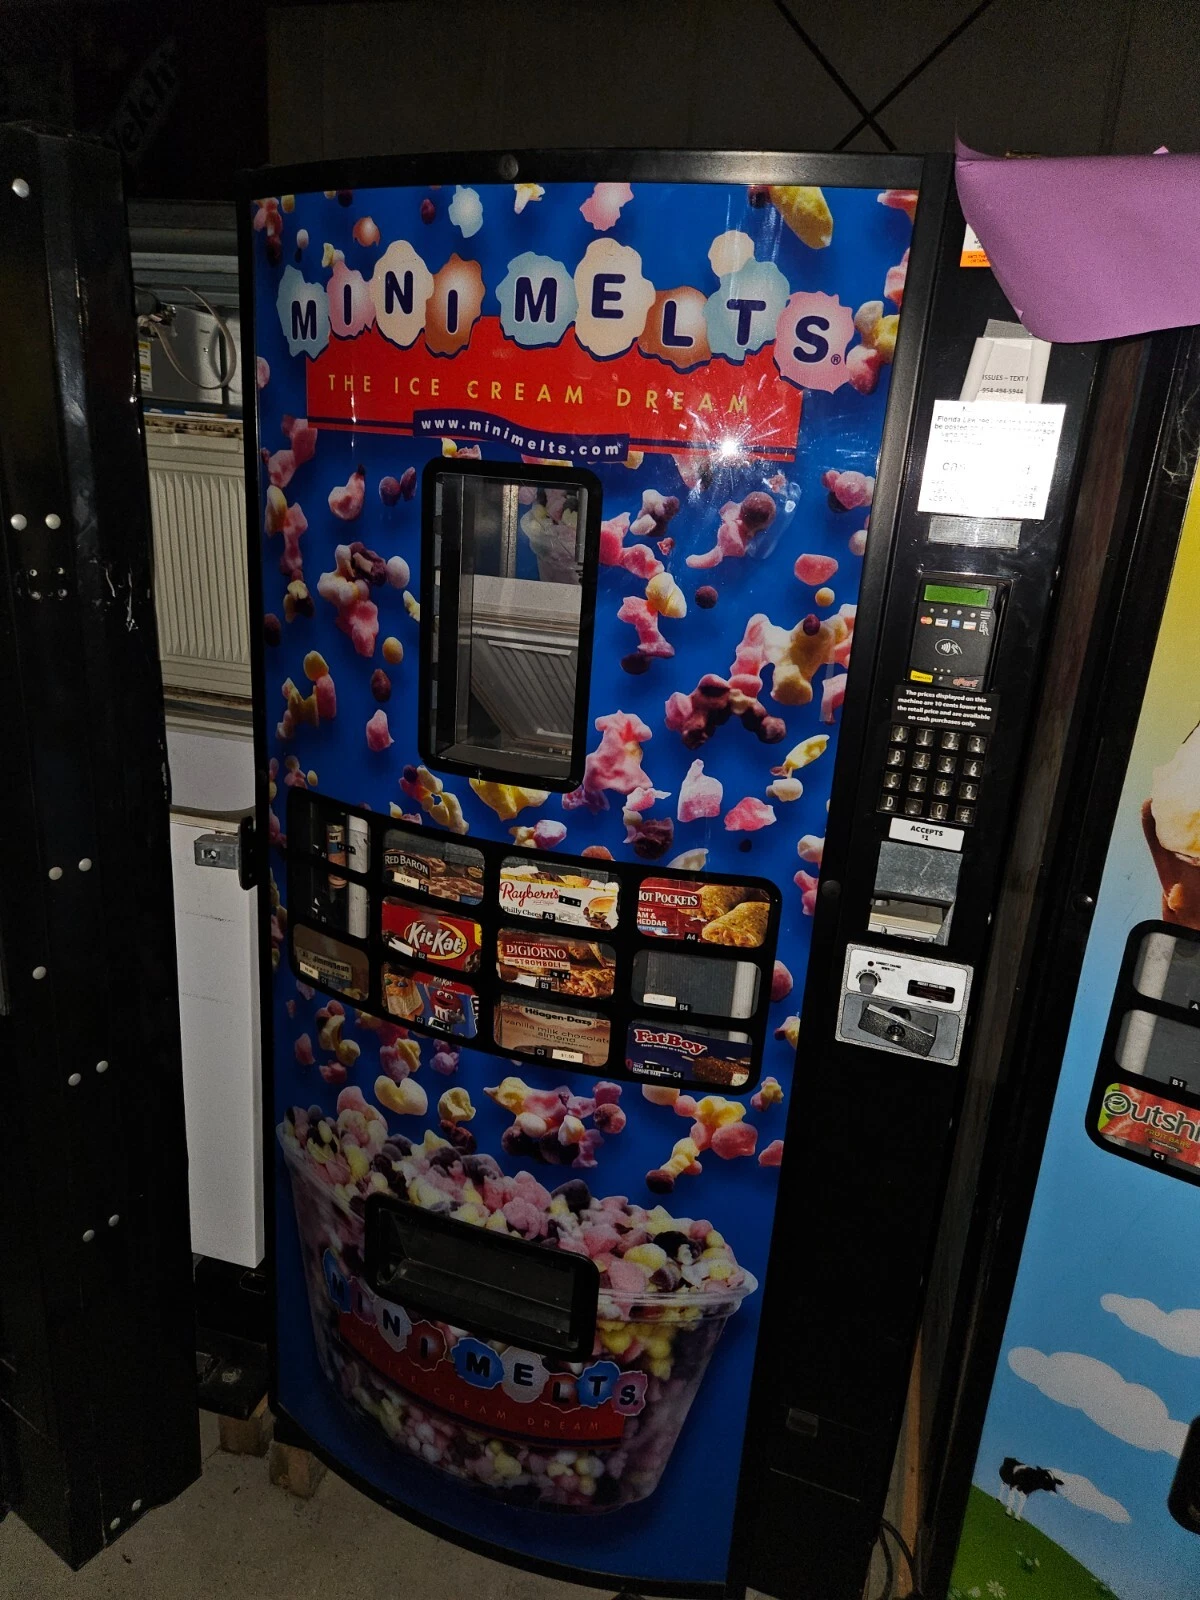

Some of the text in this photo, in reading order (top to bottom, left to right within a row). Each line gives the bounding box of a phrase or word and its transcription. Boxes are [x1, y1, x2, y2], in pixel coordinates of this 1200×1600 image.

[290, 269, 833, 364] MINI MELTS
[329, 374, 747, 415] THE ICE CREAM DREAM
[937, 415, 961, 423] Florida
[421, 418, 620, 457] www.minimelts.com
[894, 750, 901, 762] B
[919, 754, 926, 768] 4
[944, 757, 952, 771] 5
[970, 761, 978, 776] 6
[890, 774, 897, 786] C
[939, 781, 947, 794] 8
[966, 785, 973, 798] 9
[887, 796, 894, 807] D
[936, 804, 943, 817] 0
[910, 825, 944, 837] ACCEPTS
[385, 854, 429, 876] RED BARON
[500, 881, 560, 908] Raybern's
[655, 891, 698, 906] POCKETS
[408, 921, 463, 956] KitKat
[686, 933, 696, 941] A4
[514, 959, 561, 968] STROMBOLI
[679, 1004, 689, 1012] B4
[504, 1019, 535, 1031] vanilla
[537, 1027, 559, 1035] milk
[537, 1032, 576, 1043] almond
[536, 1048, 545, 1056] C3
[672, 1071, 682, 1079] C4
[1172, 1078, 1184, 1088] B1
[1153, 1152, 1165, 1160] C1
[465, 1350, 641, 1407] MELTS
[527, 1414, 600, 1432] DREAM
